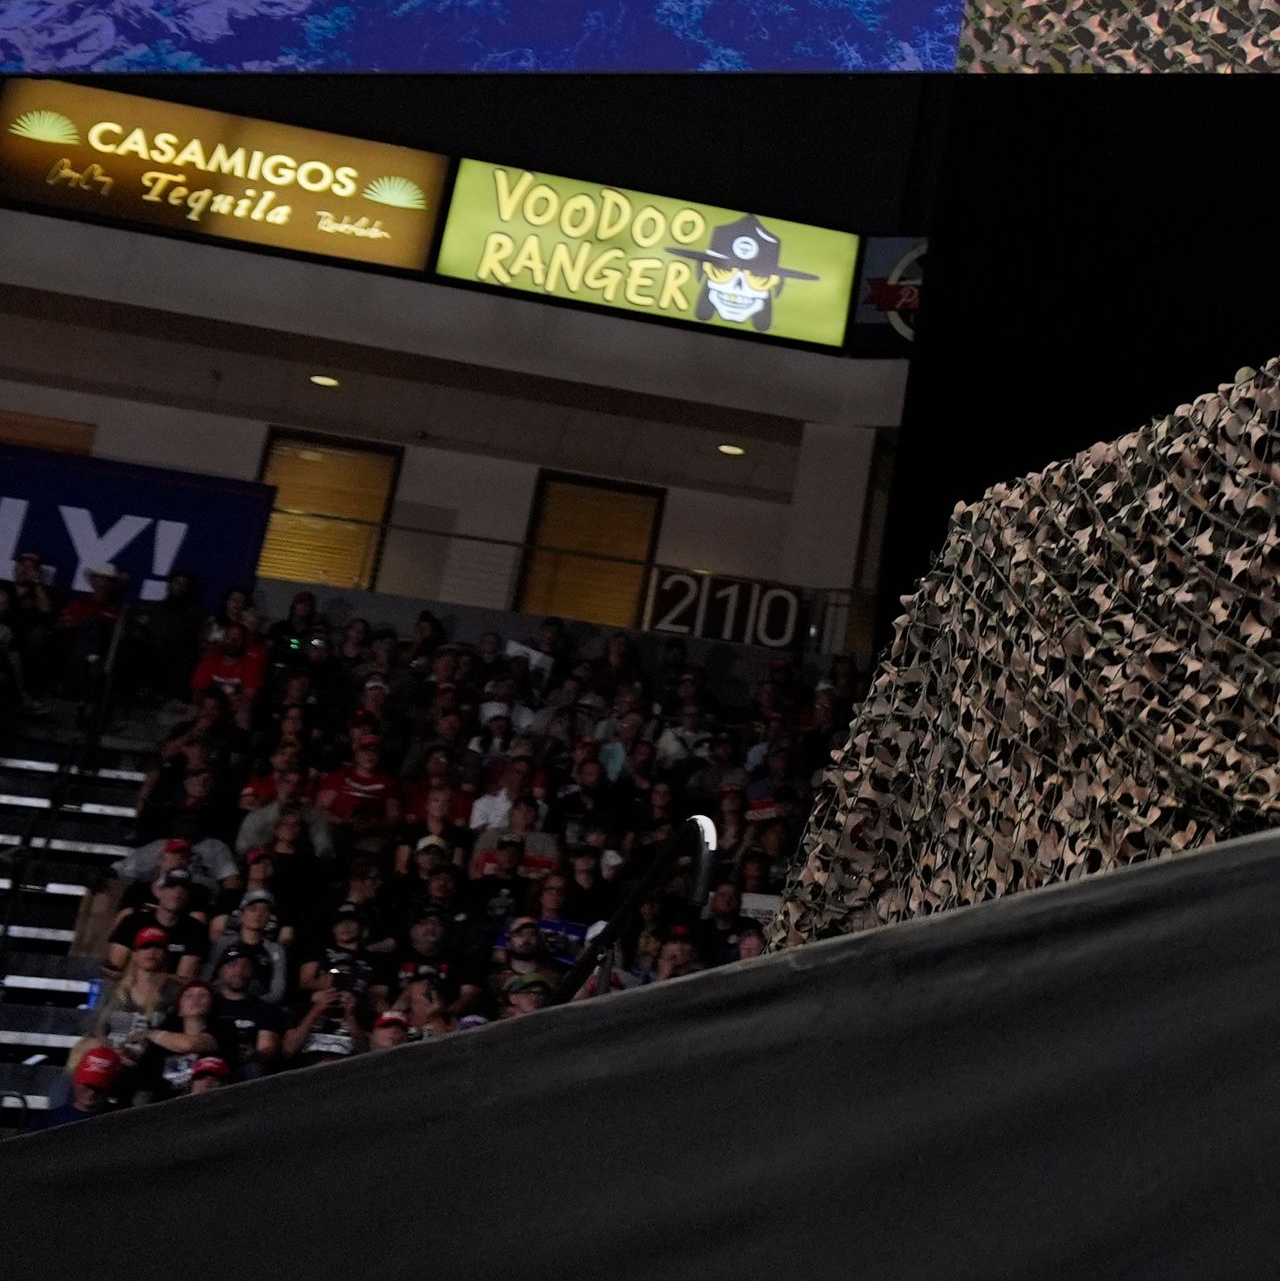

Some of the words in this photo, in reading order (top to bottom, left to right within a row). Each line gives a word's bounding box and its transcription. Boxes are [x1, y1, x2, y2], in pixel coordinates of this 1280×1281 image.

[87, 121, 360, 198] CASAMIGOS
[141, 171, 293, 227] Tequila
[493, 167, 707, 249] VOODOO
[476, 231, 693, 313] RANGER
